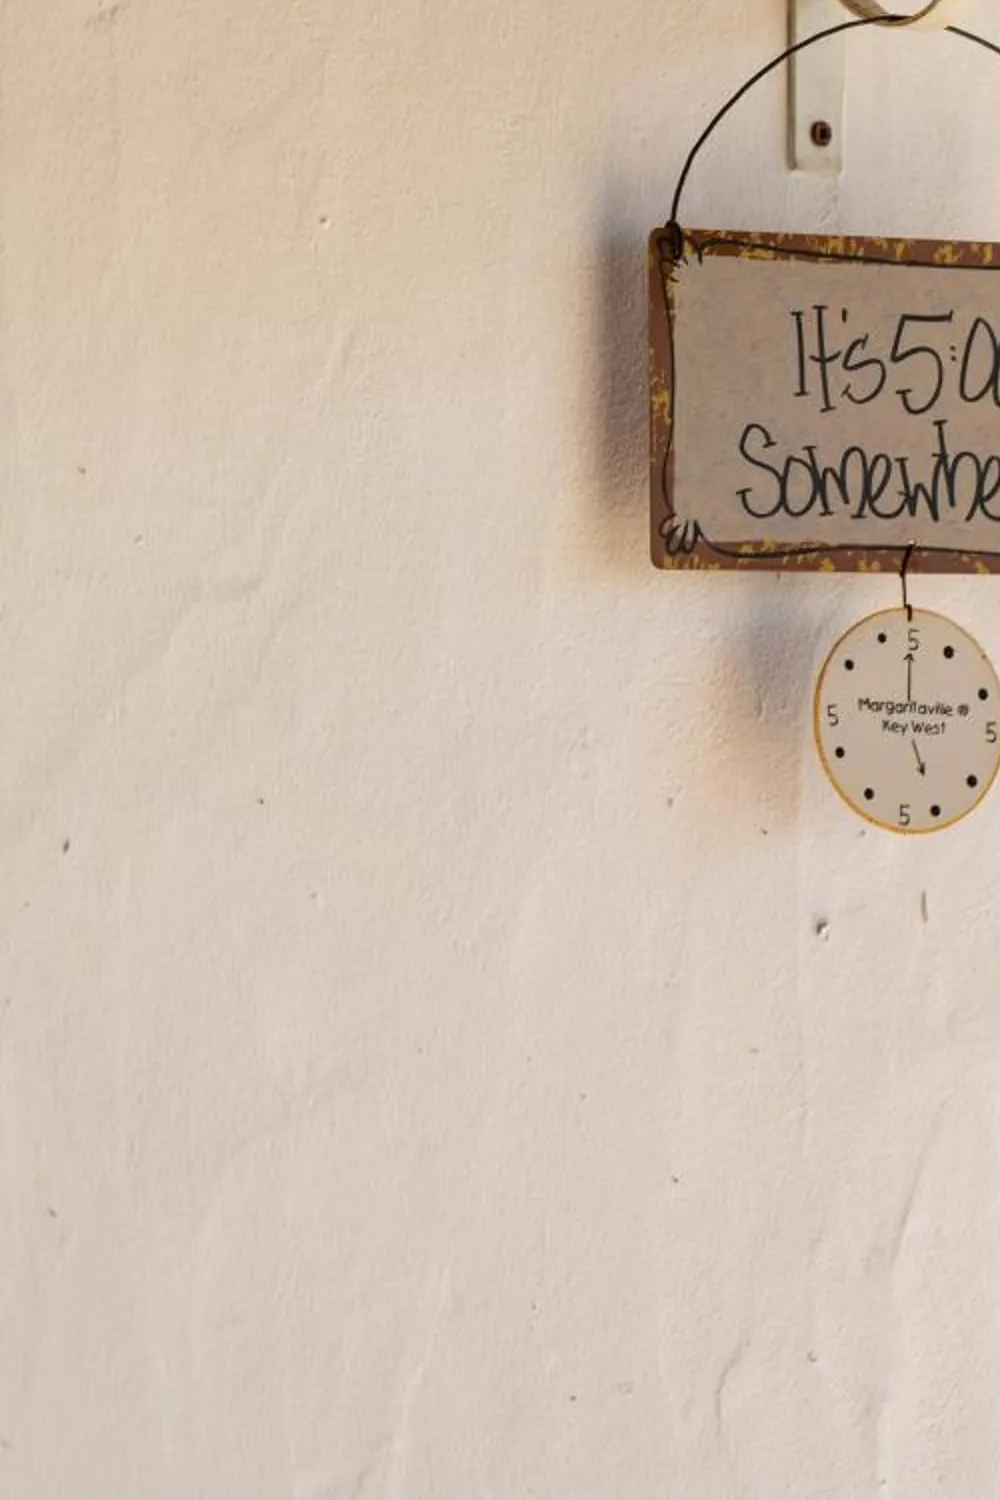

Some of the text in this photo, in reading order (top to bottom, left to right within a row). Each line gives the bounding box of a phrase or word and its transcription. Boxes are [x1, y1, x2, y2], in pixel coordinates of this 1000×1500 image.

[907, 628, 920, 651] 5
[827, 704, 839, 727] 5
[881, 719, 946, 737] Key West
[985, 721, 998, 744] 5
[898, 803, 911, 827] 5
